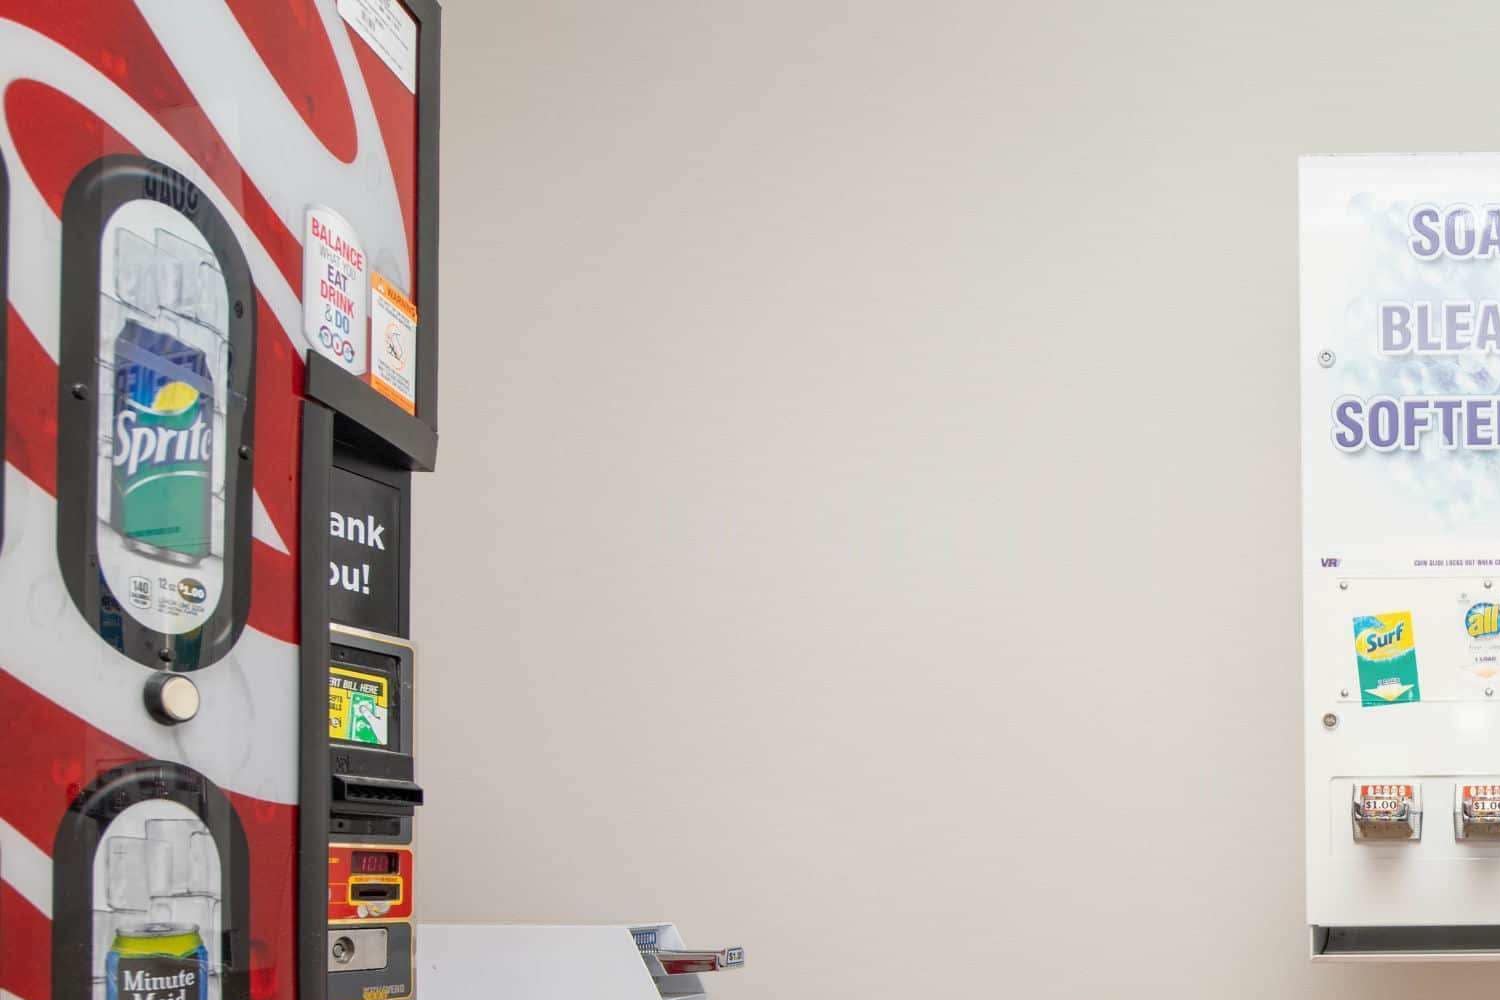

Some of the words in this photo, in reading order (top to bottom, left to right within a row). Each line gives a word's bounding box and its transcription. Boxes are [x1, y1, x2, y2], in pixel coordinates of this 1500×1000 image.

[312, 216, 363, 271] BALANCE
[319, 243, 340, 268] WHAT
[327, 263, 348, 292] EAT
[320, 279, 355, 319] DRINK
[324, 303, 333, 322] &
[335, 311, 350, 335] DO
[112, 408, 212, 477] Sprite
[1468, 603, 1500, 638] all
[1366, 621, 1405, 654] Surf
[342, 679, 358, 691] BILL
[359, 683, 379, 695] HERE
[1365, 800, 1398, 810] $1.00
[123, 968, 196, 992] Minute
